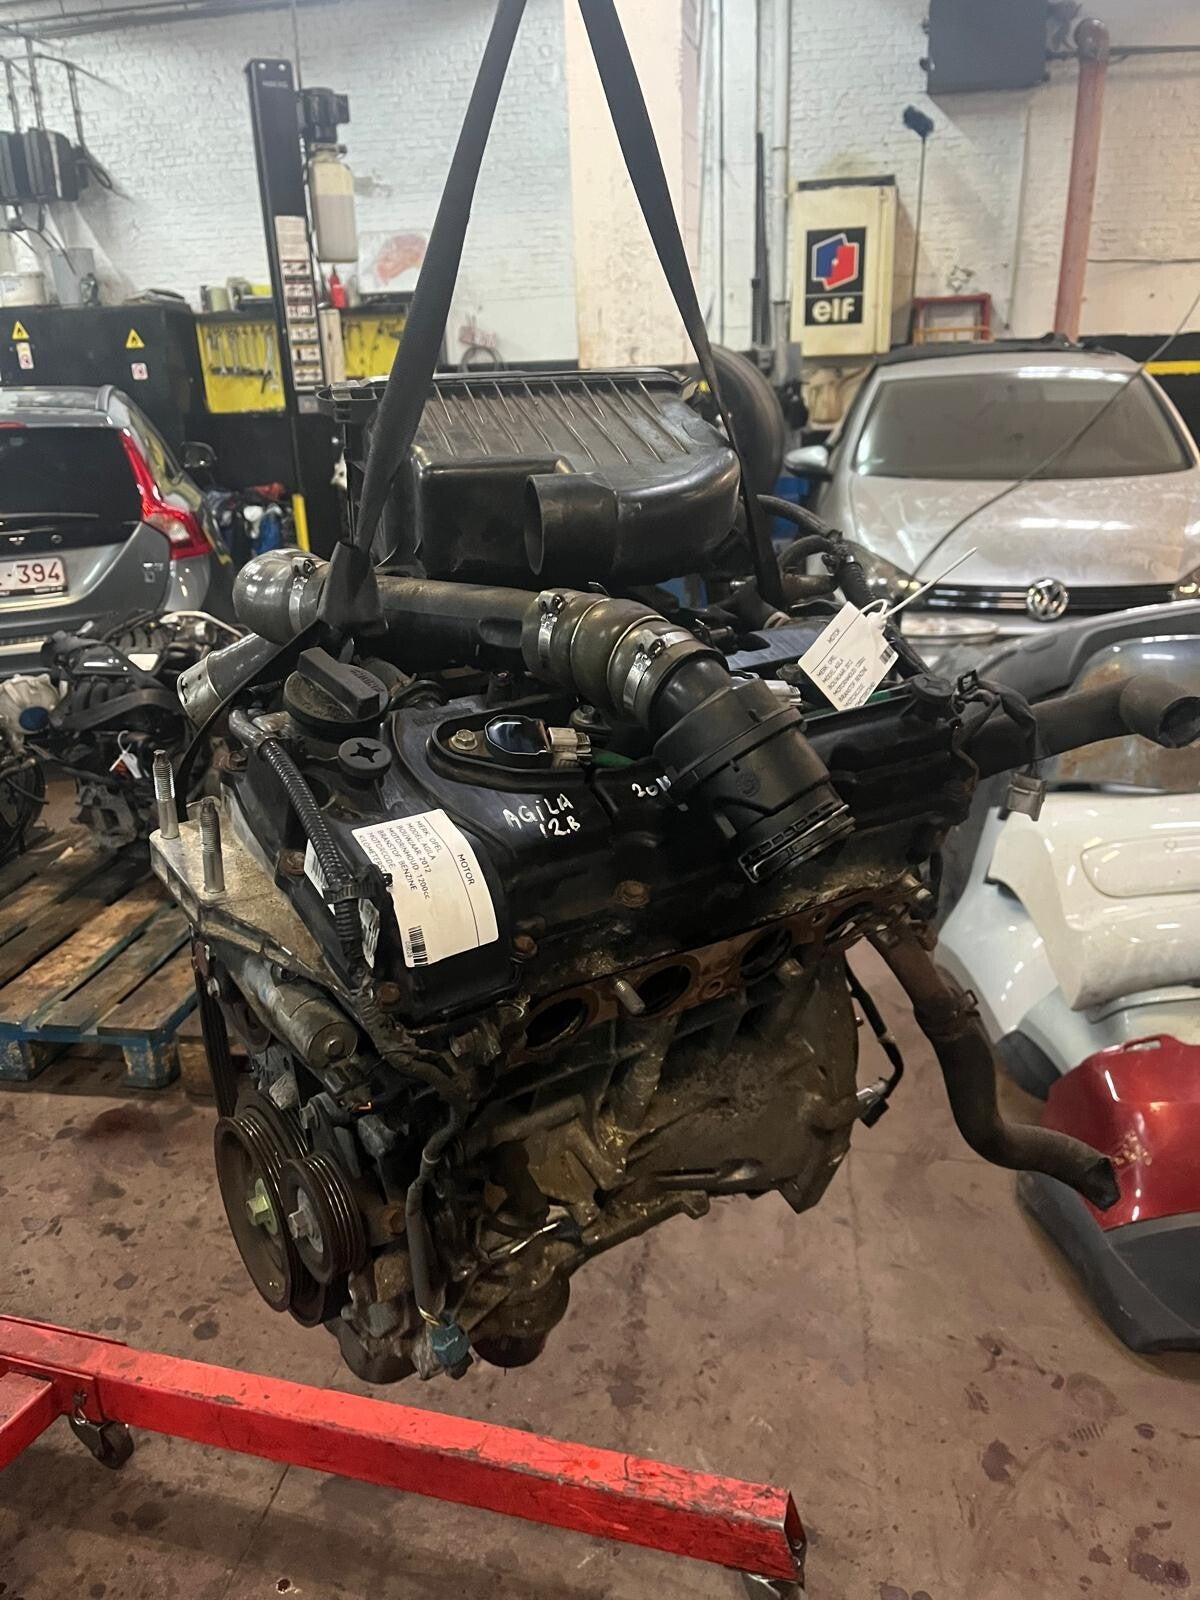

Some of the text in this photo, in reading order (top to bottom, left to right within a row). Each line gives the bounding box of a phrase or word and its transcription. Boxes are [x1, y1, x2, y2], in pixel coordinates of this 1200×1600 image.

[812, 297, 855, 322] elf
[422, 843, 436, 860] AGILA
[429, 838, 443, 853] OPEL
[398, 860, 417, 891] BENZINE
[419, 857, 431, 873] 2012
[457, 854, 476, 885] MOTOR
[416, 874, 430, 899] 1200cc
